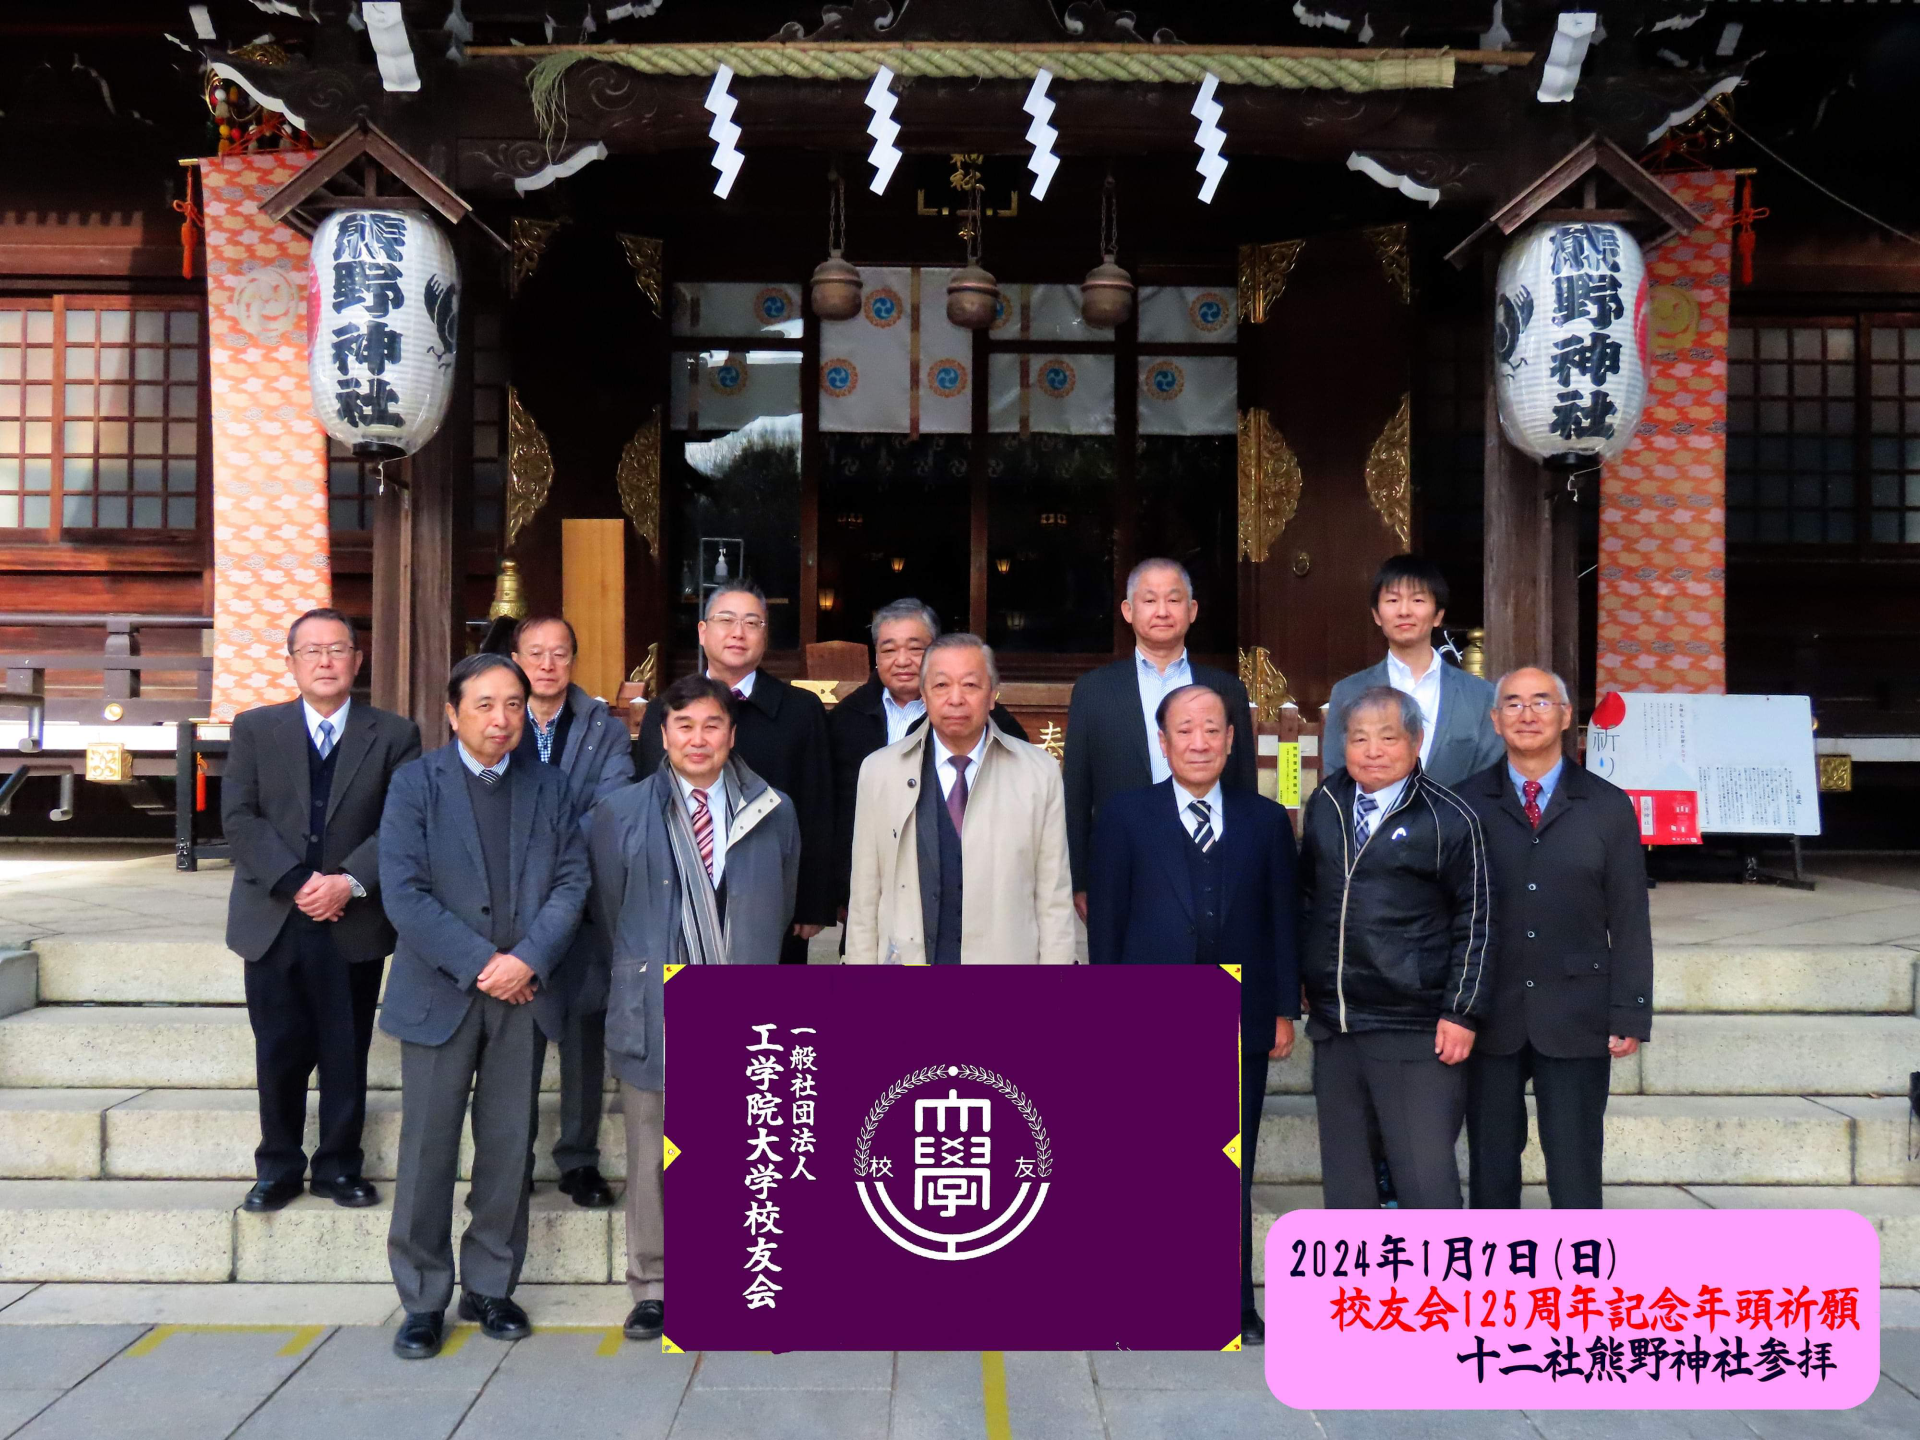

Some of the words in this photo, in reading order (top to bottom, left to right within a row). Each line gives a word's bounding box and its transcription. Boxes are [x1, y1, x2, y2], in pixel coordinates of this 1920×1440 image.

[332, 213, 407, 429] 熊野神社
[1549, 224, 1625, 441] 熊野神社
[742, 1023, 785, 1310] 工学院大学校友会
[790, 1027, 818, 1181] 一般社団法人
[869, 1156, 894, 1178] 校
[1014, 1156, 1037, 1178] 友
